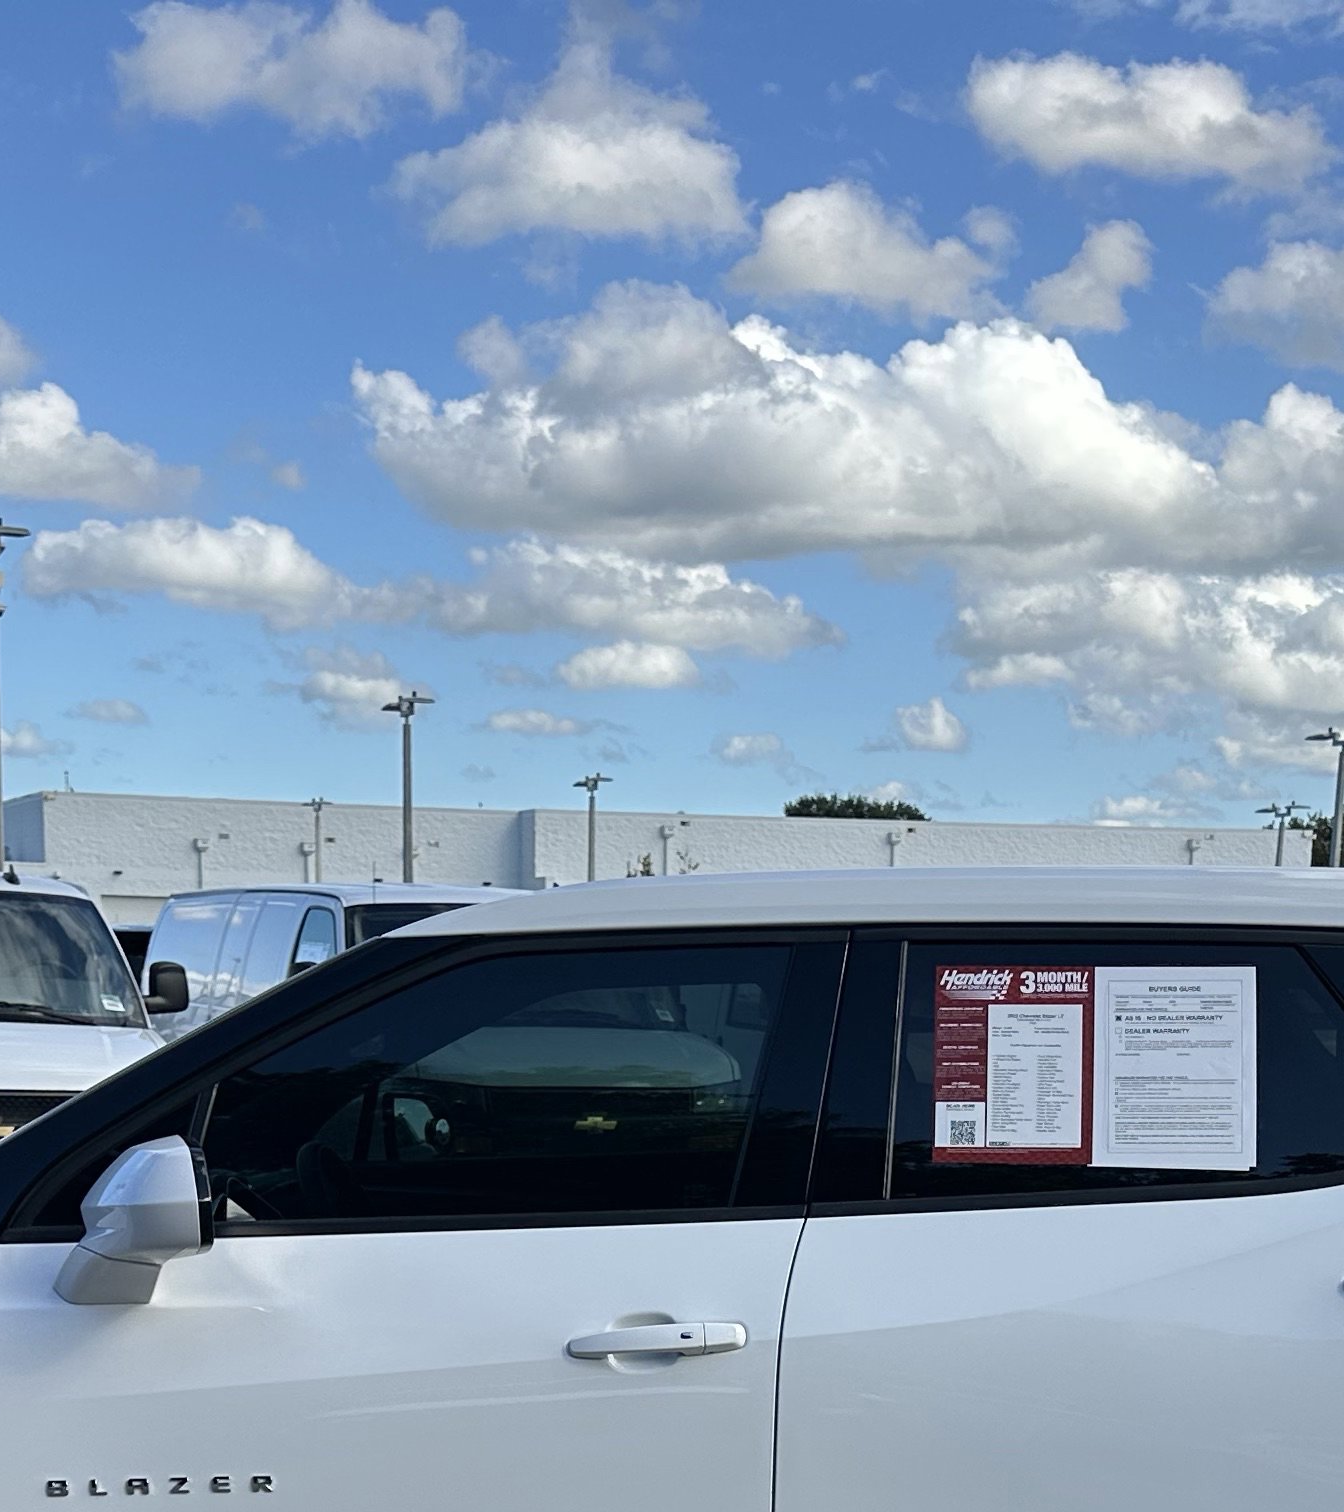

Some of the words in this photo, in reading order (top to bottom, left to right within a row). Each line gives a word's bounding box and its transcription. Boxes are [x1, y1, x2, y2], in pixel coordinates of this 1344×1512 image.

[940, 969, 1014, 989] Hendrick
[1019, 971, 1036, 994] 3
[1036, 971, 1089, 983] MONTH/
[1036, 983, 1063, 993] 3,000
[1065, 983, 1089, 992] MILE
[45, 1475, 274, 1498] BLAZER
